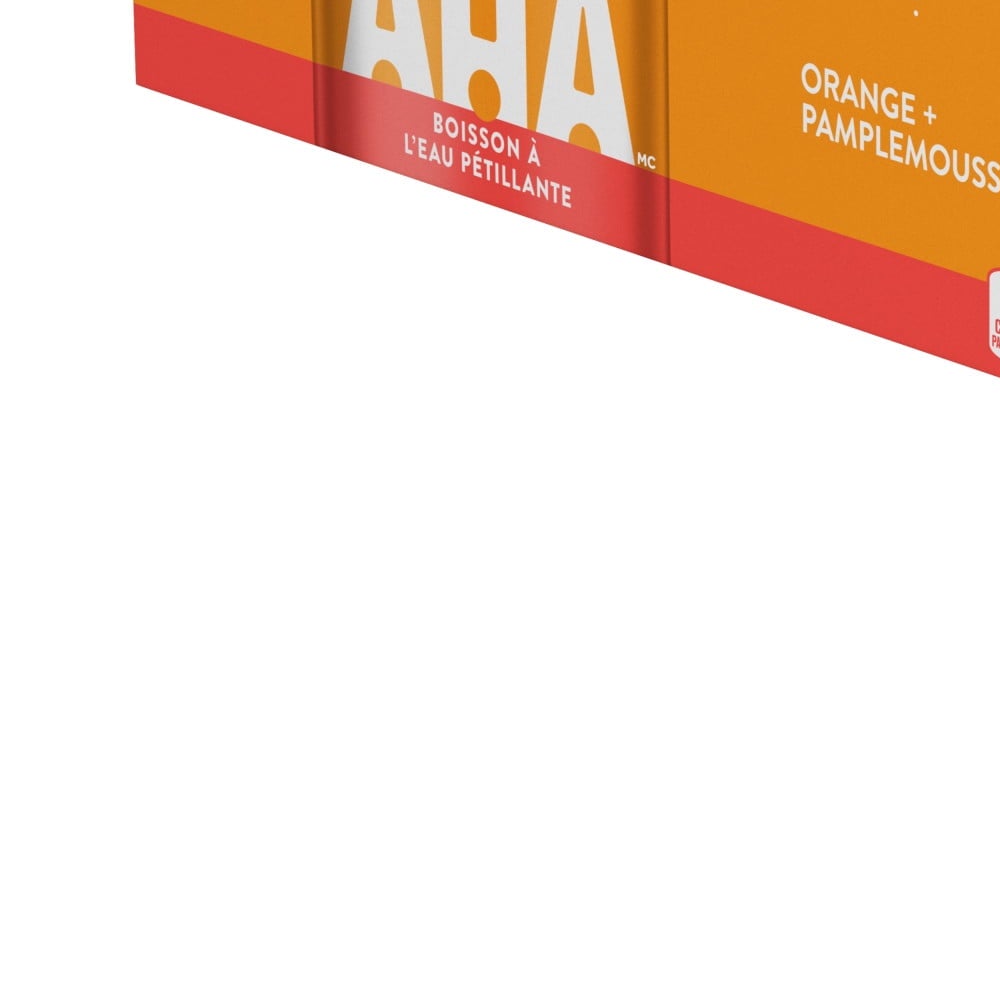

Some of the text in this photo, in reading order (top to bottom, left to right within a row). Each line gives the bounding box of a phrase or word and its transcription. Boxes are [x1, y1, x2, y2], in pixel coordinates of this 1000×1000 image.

[801, 62, 937, 126] ORANGE +
[433, 111, 541, 167] BOISSON À
[636, 151, 657, 170] MC
[404, 132, 572, 208] L'EAU PÉTILLANTE
